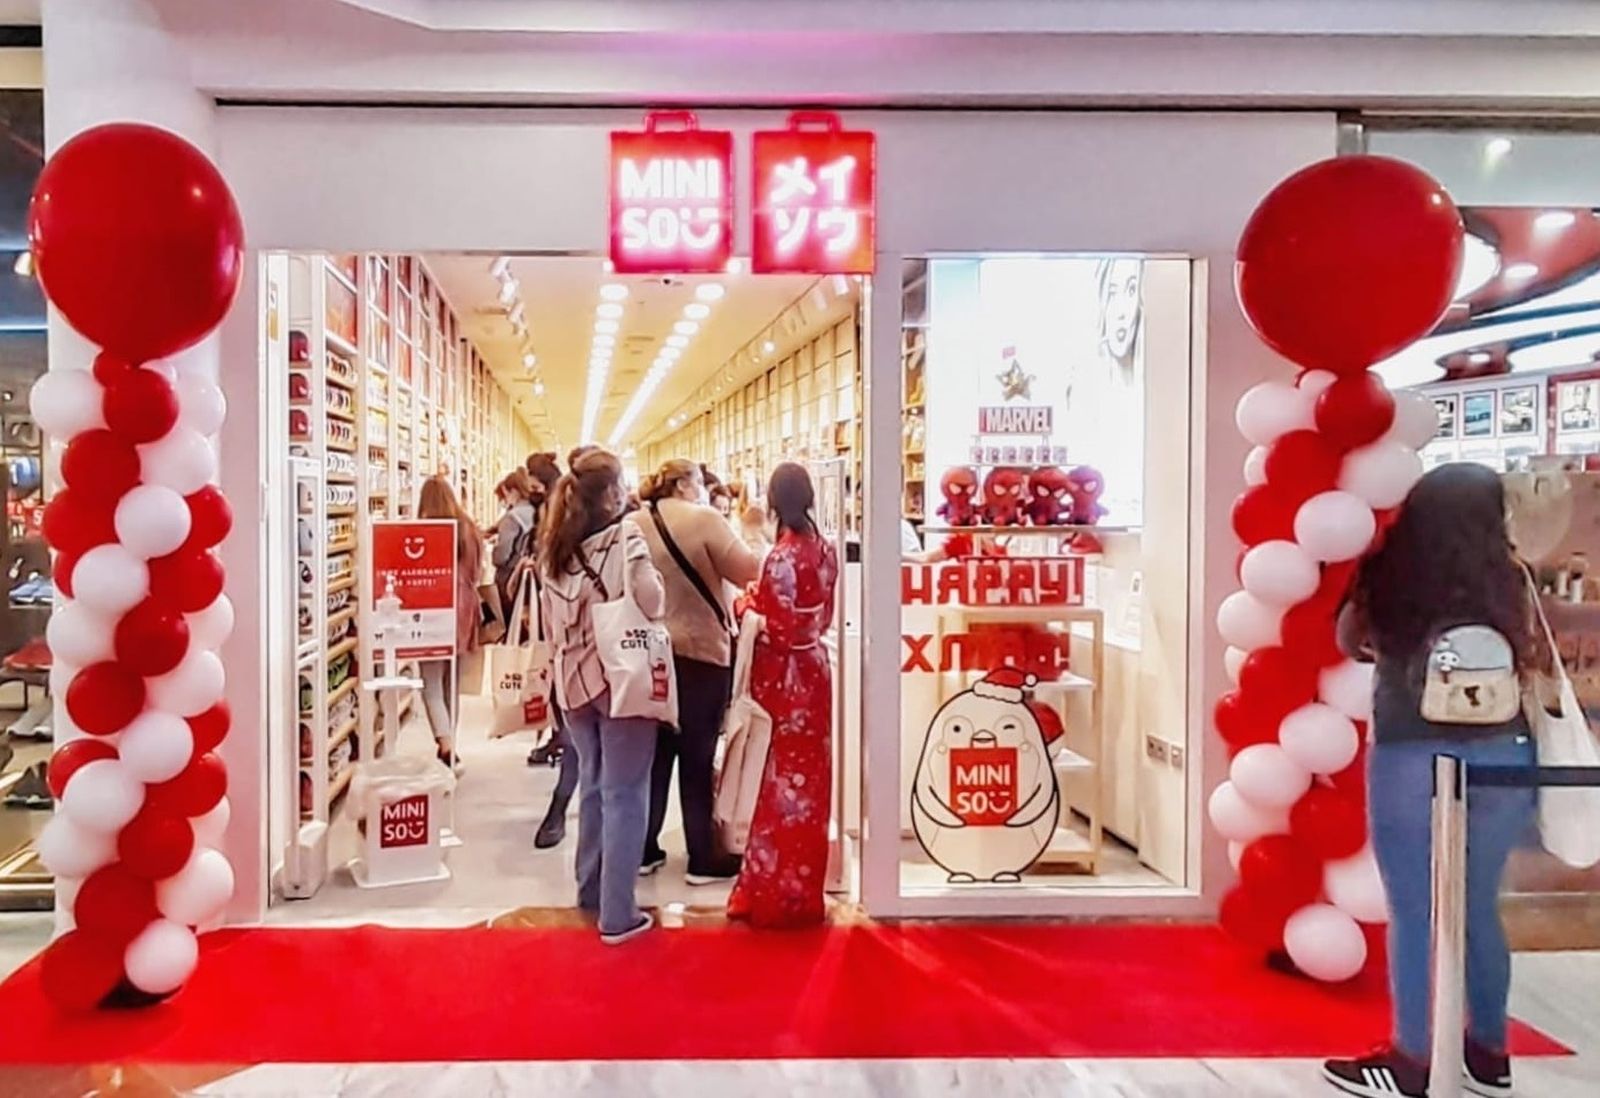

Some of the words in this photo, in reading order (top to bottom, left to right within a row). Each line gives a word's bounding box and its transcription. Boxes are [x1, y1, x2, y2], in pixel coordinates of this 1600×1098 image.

[619, 158, 720, 200] MINI
[769, 155, 857, 202] メイ
[773, 206, 858, 255] ソウ
[986, 406, 1050, 433] MARVEL
[956, 763, 1011, 786] MINI
[383, 801, 425, 820] MINI
